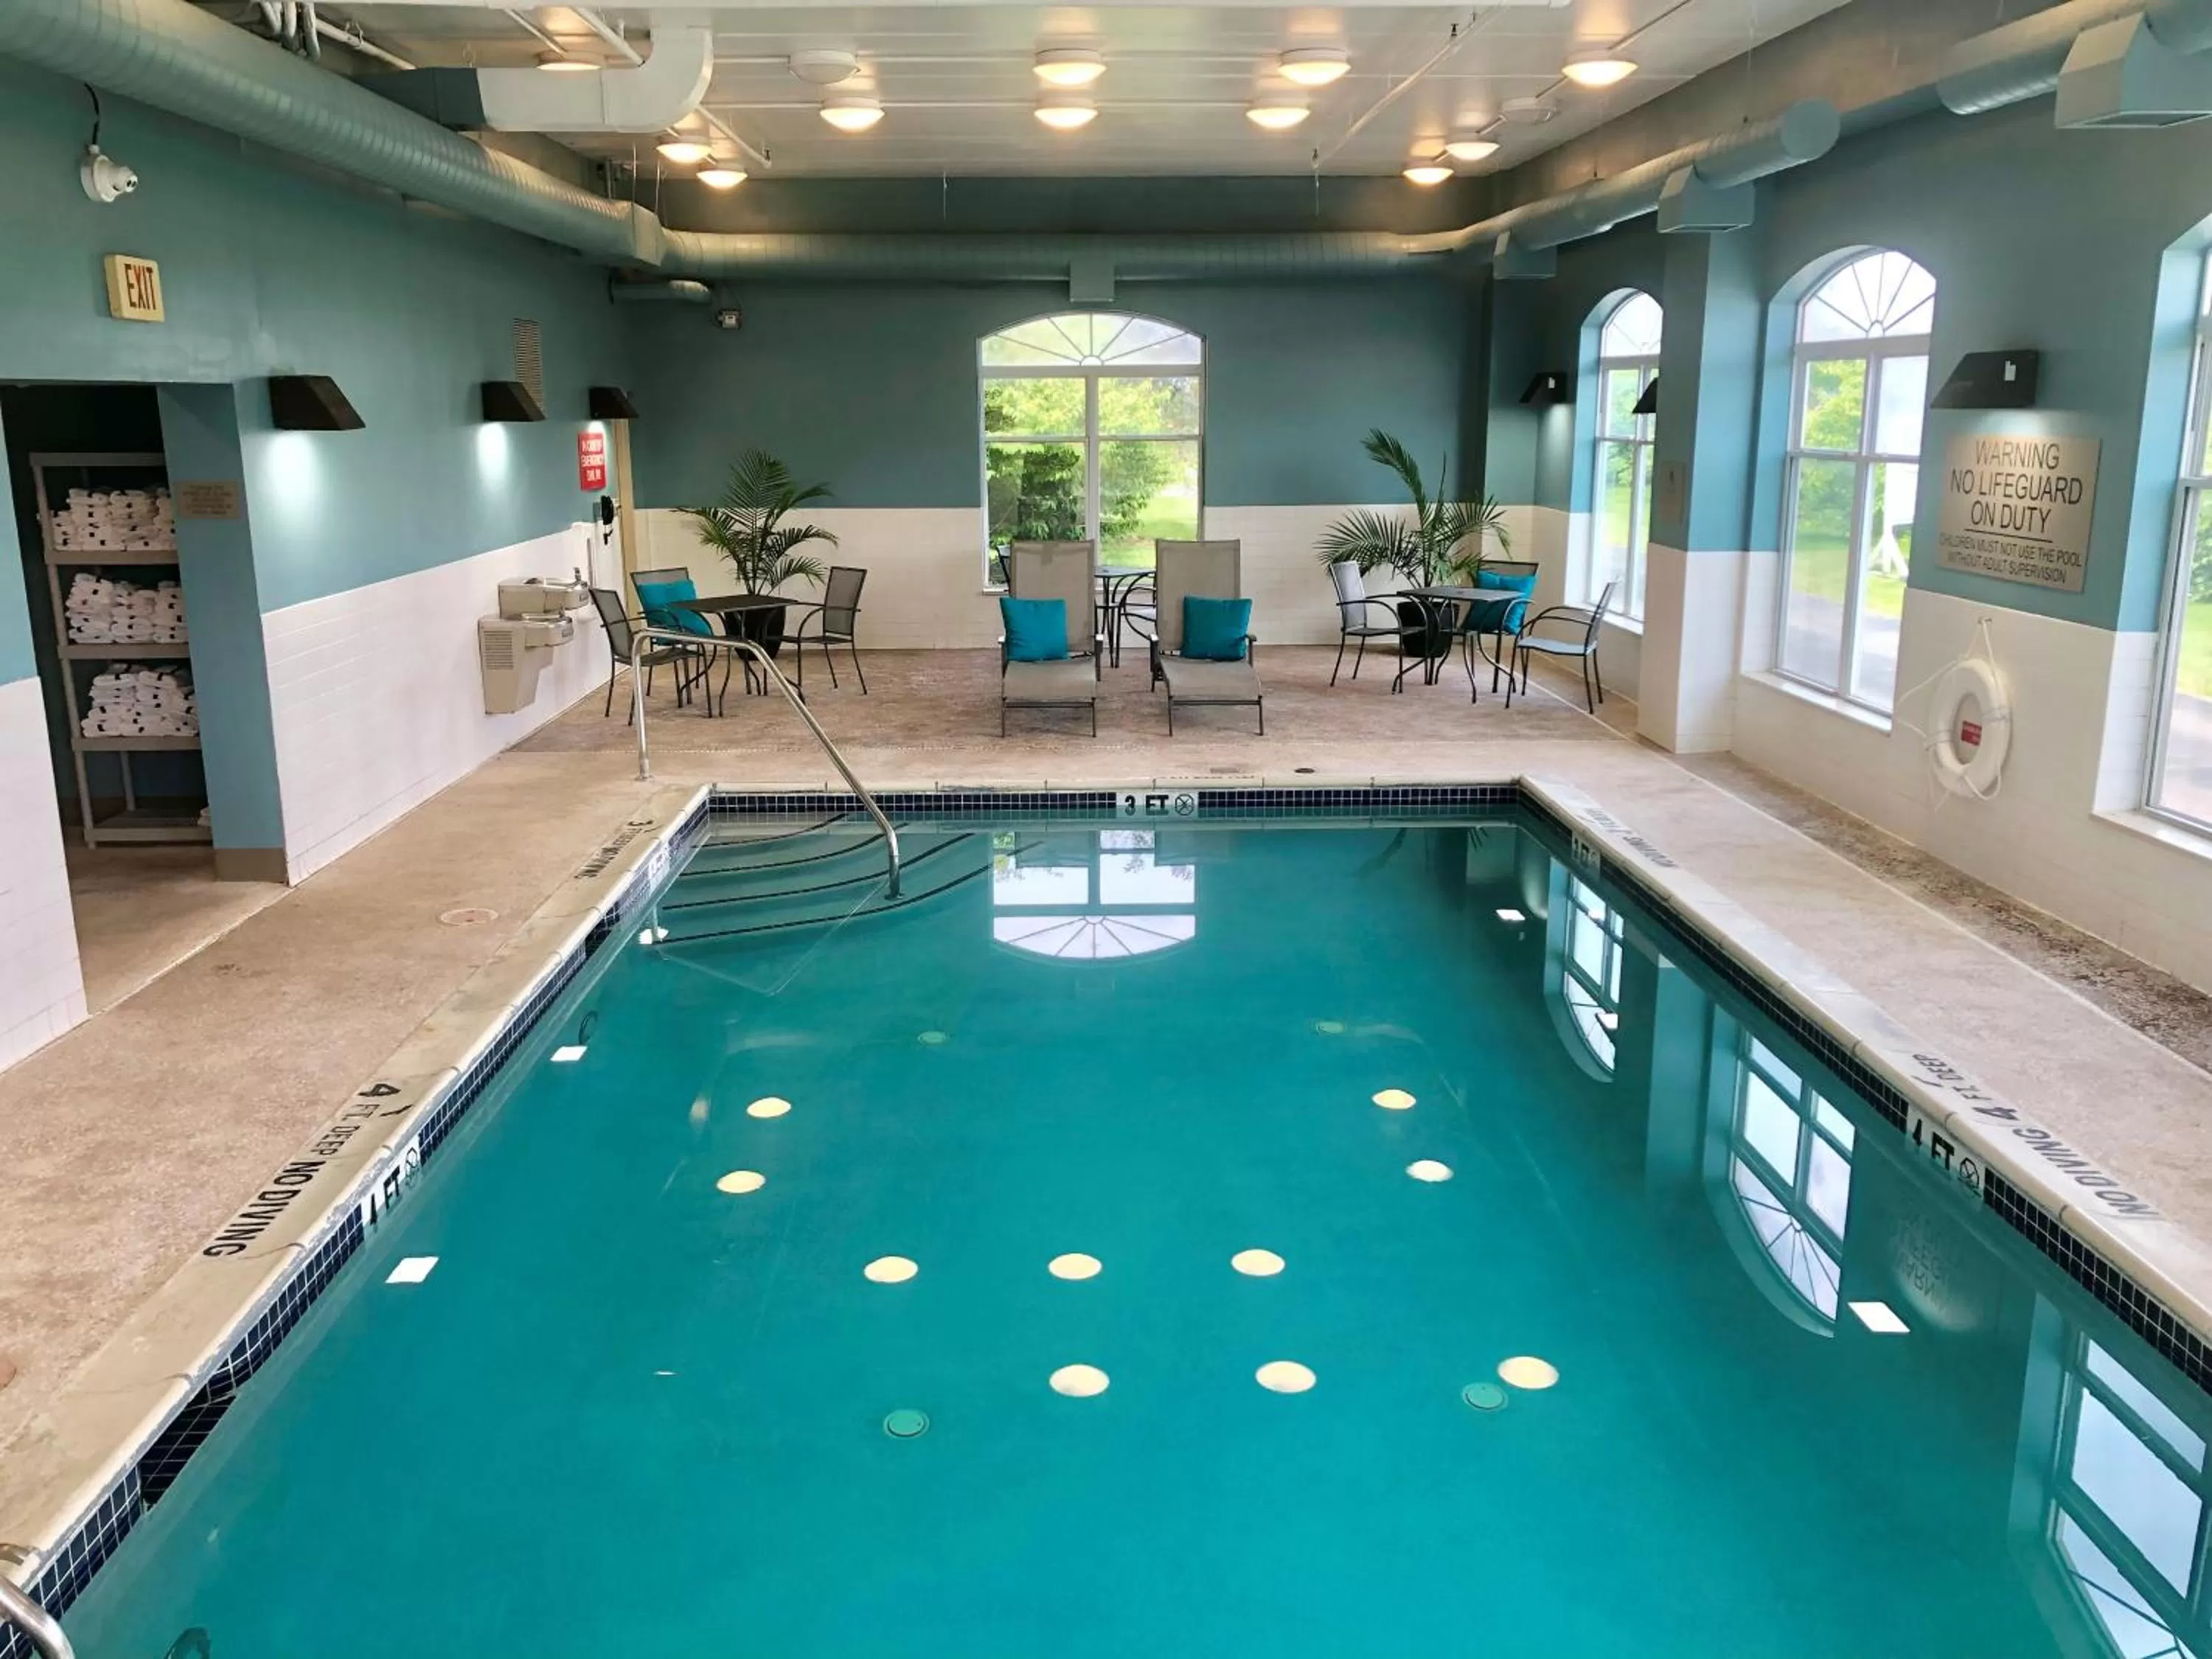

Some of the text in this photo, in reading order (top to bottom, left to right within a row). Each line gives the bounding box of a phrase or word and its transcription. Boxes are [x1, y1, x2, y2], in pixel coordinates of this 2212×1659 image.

[124, 263, 156, 310] EXIT
[1975, 439, 2060, 470] WARNING
[1950, 468, 2083, 505] NO LIFEGUARD
[1970, 500, 2051, 533] ON DUTY
[2000, 542, 2017, 557] NOT
[2019, 545, 2035, 560] USE
[2038, 546, 2055, 563] THE
[2056, 550, 2082, 567] POOL
[1913, 1054, 1964, 1080] DEEP
[358, 1083, 402, 1097] 4
[1972, 1106, 2020, 1121] 4
[310, 1125, 361, 1155] DEEP
[2012, 1127, 2119, 1186] DIVING
[273, 1160, 327, 1186] NO
[2095, 1189, 2166, 1221] NO
[203, 1189, 302, 1257] DIVING
